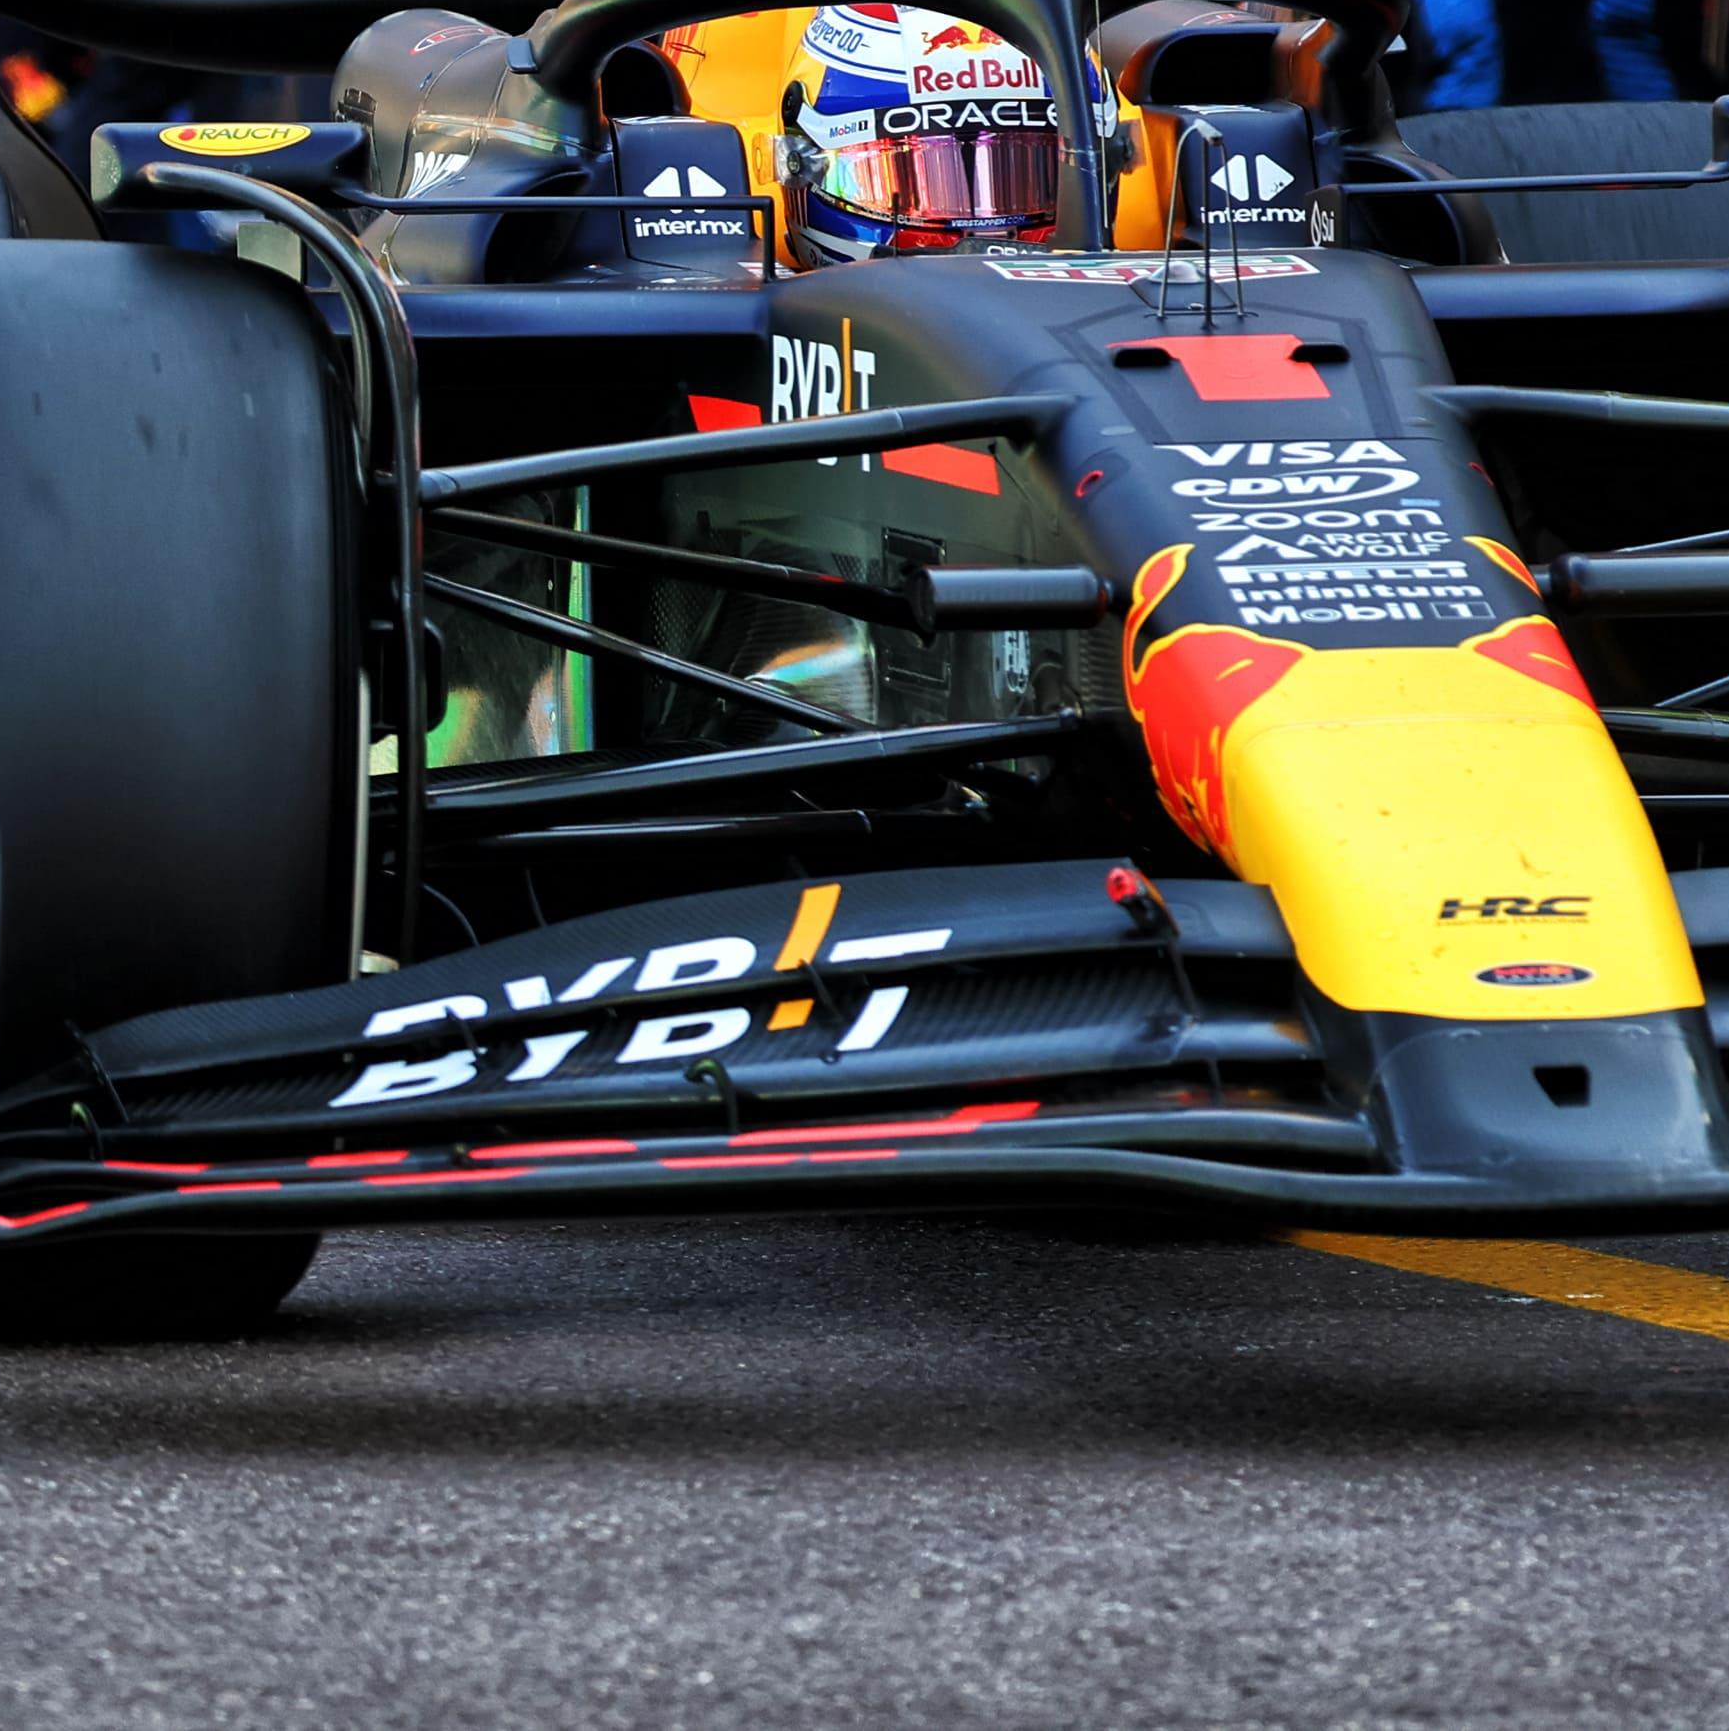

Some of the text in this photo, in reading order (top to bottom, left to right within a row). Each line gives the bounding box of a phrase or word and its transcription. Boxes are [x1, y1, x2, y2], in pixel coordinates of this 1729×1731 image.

[914, 58, 1039, 94] Red Bull
[197, 124, 290, 142] RAUCH
[829, 120, 857, 138] Mobil
[634, 217, 745, 238] inter.mx
[1153, 440, 1408, 466] VISA
[1172, 475, 1361, 497] CDW
[1190, 509, 1445, 532] zoom
[1295, 531, 1453, 547] ARCTIC
[1321, 543, 1442, 558] WOLF
[1217, 561, 1469, 584] PIRELLI
[1237, 603, 1422, 626] Mobil
[1438, 896, 1593, 920] HRC
